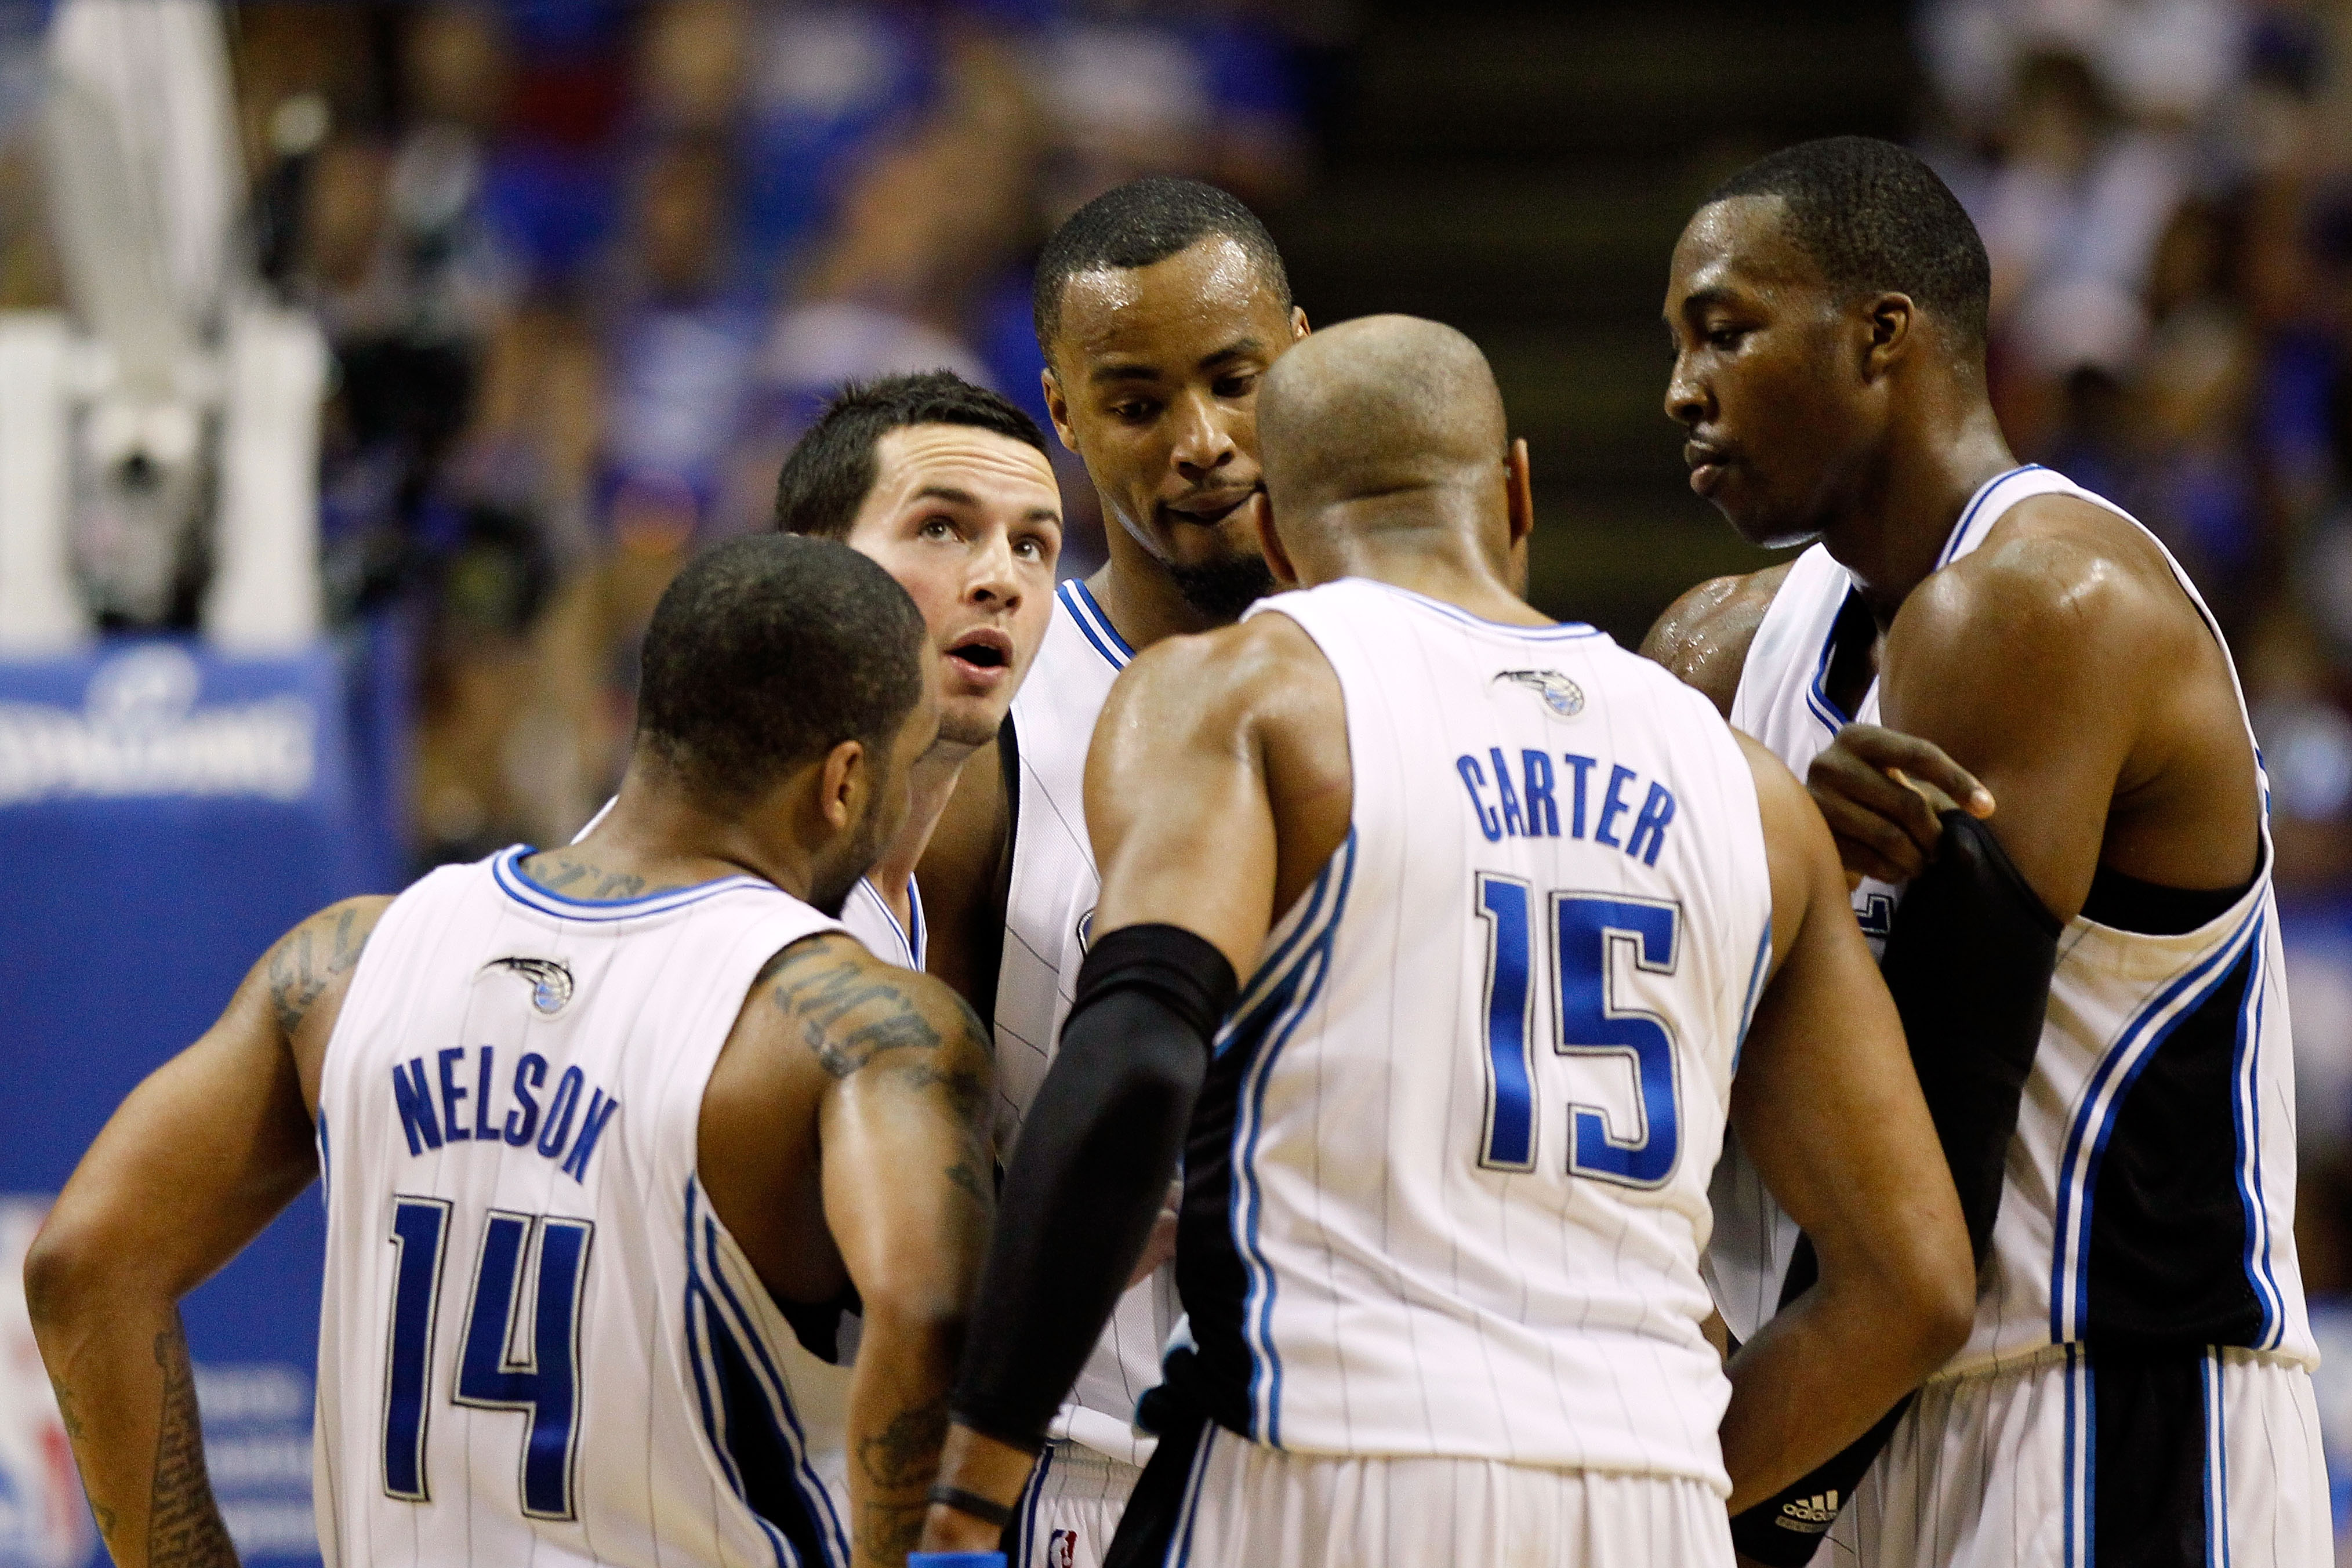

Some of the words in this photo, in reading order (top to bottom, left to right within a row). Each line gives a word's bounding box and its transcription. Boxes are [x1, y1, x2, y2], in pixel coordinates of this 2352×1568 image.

[1456, 747, 1677, 867] CARTER
[1475, 871, 1682, 1191] 15
[393, 1045, 620, 1184] NELSON
[380, 1195, 594, 1522] 14
[1783, 1502, 1838, 1522] adida
